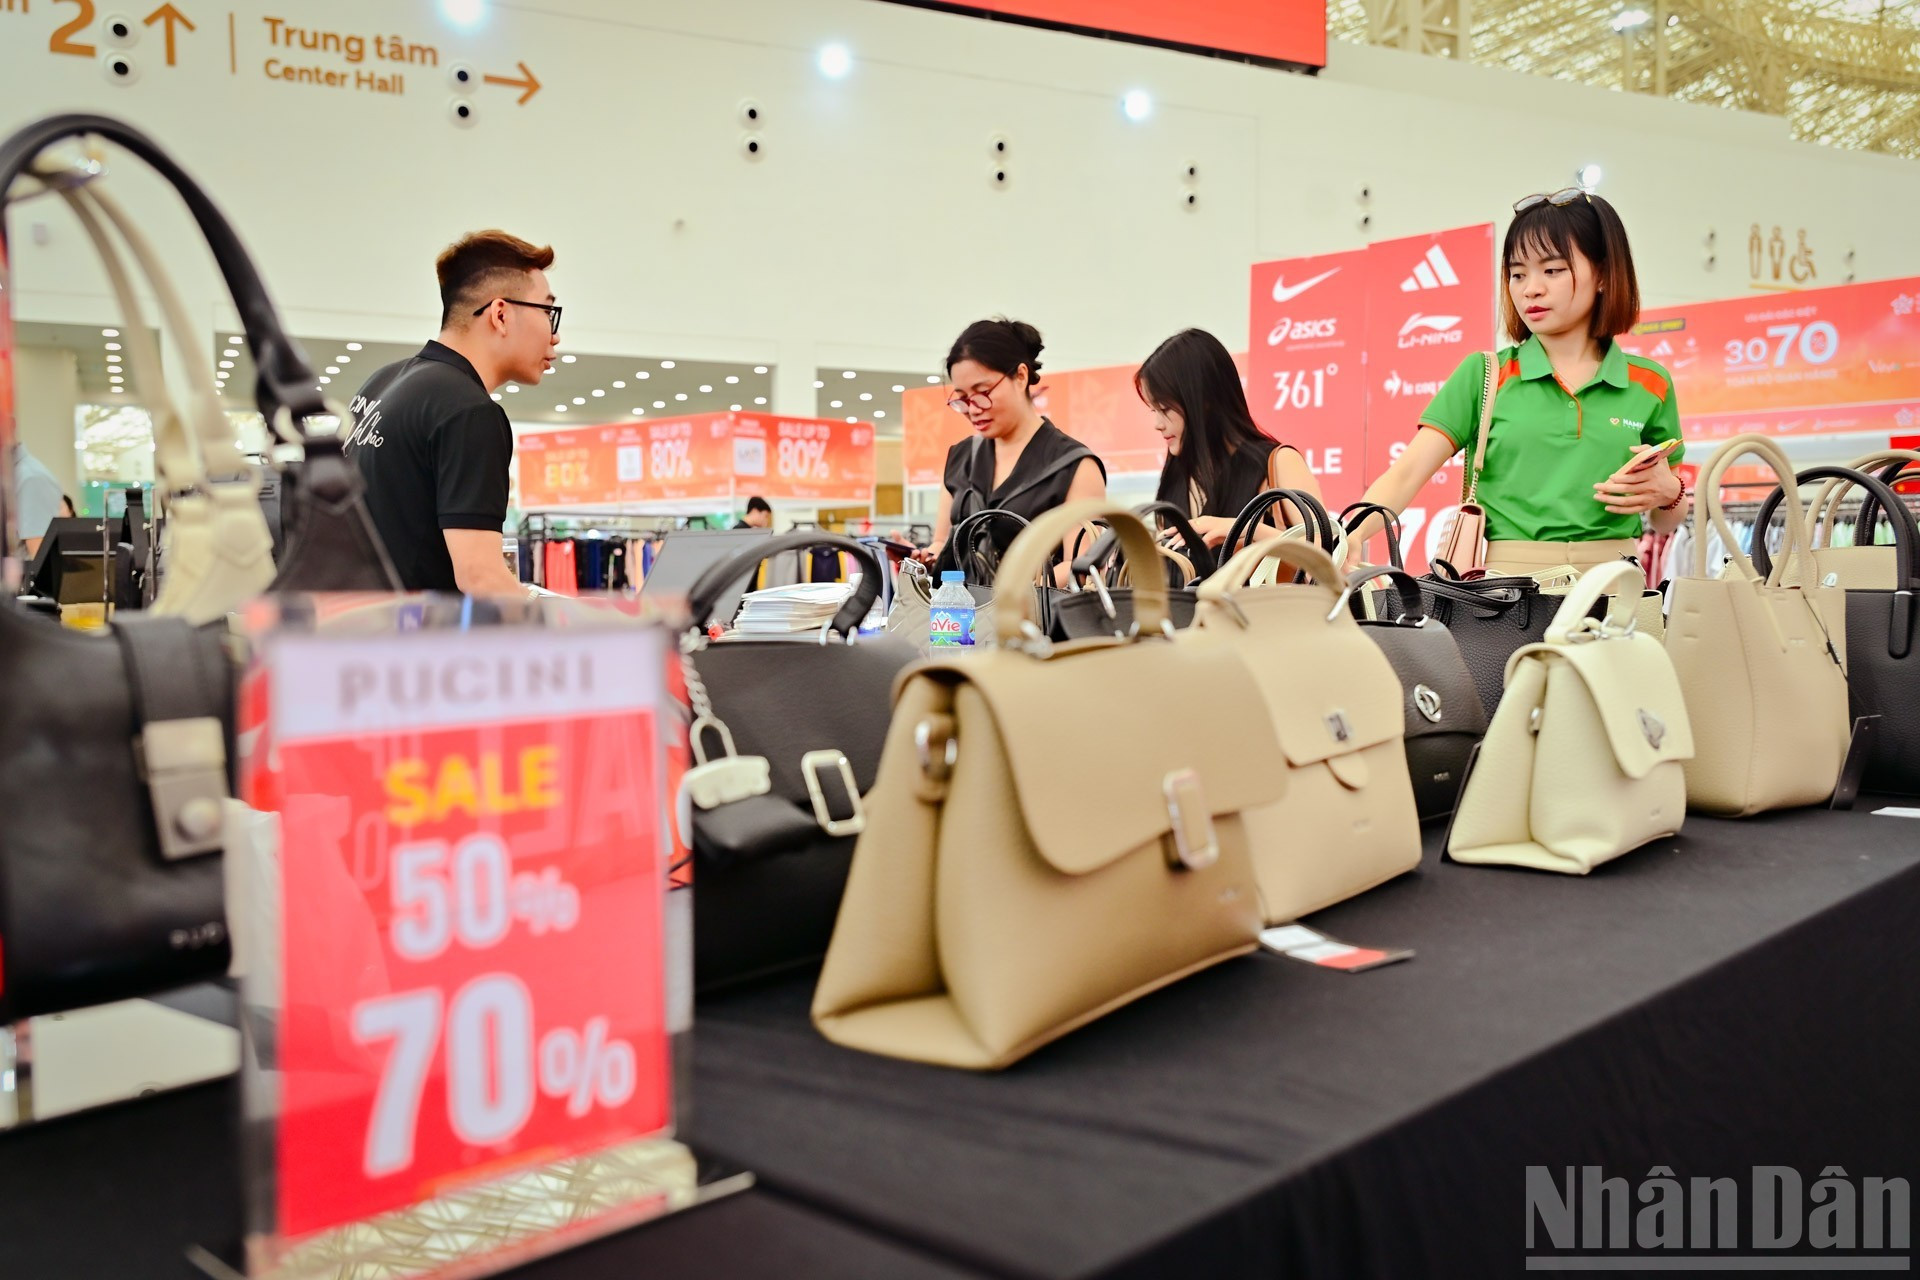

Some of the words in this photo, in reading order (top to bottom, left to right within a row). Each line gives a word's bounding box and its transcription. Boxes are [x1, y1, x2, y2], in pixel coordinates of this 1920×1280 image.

[50, 0, 96, 57] 2
[263, 16, 365, 63] Trung
[374, 34, 439, 66] tâm
[264, 58, 349, 88] Center
[355, 70, 405, 95] Hall
[1397, 330, 1463, 349] LI-NING
[651, 438, 693, 480] 80%
[778, 438, 829, 479] 80%
[931, 618, 961, 631] aVie
[338, 653, 596, 715] PUCINI
[384, 745, 559, 826] SALE
[391, 832, 582, 960] 50%
[351, 972, 637, 1178] 70%
